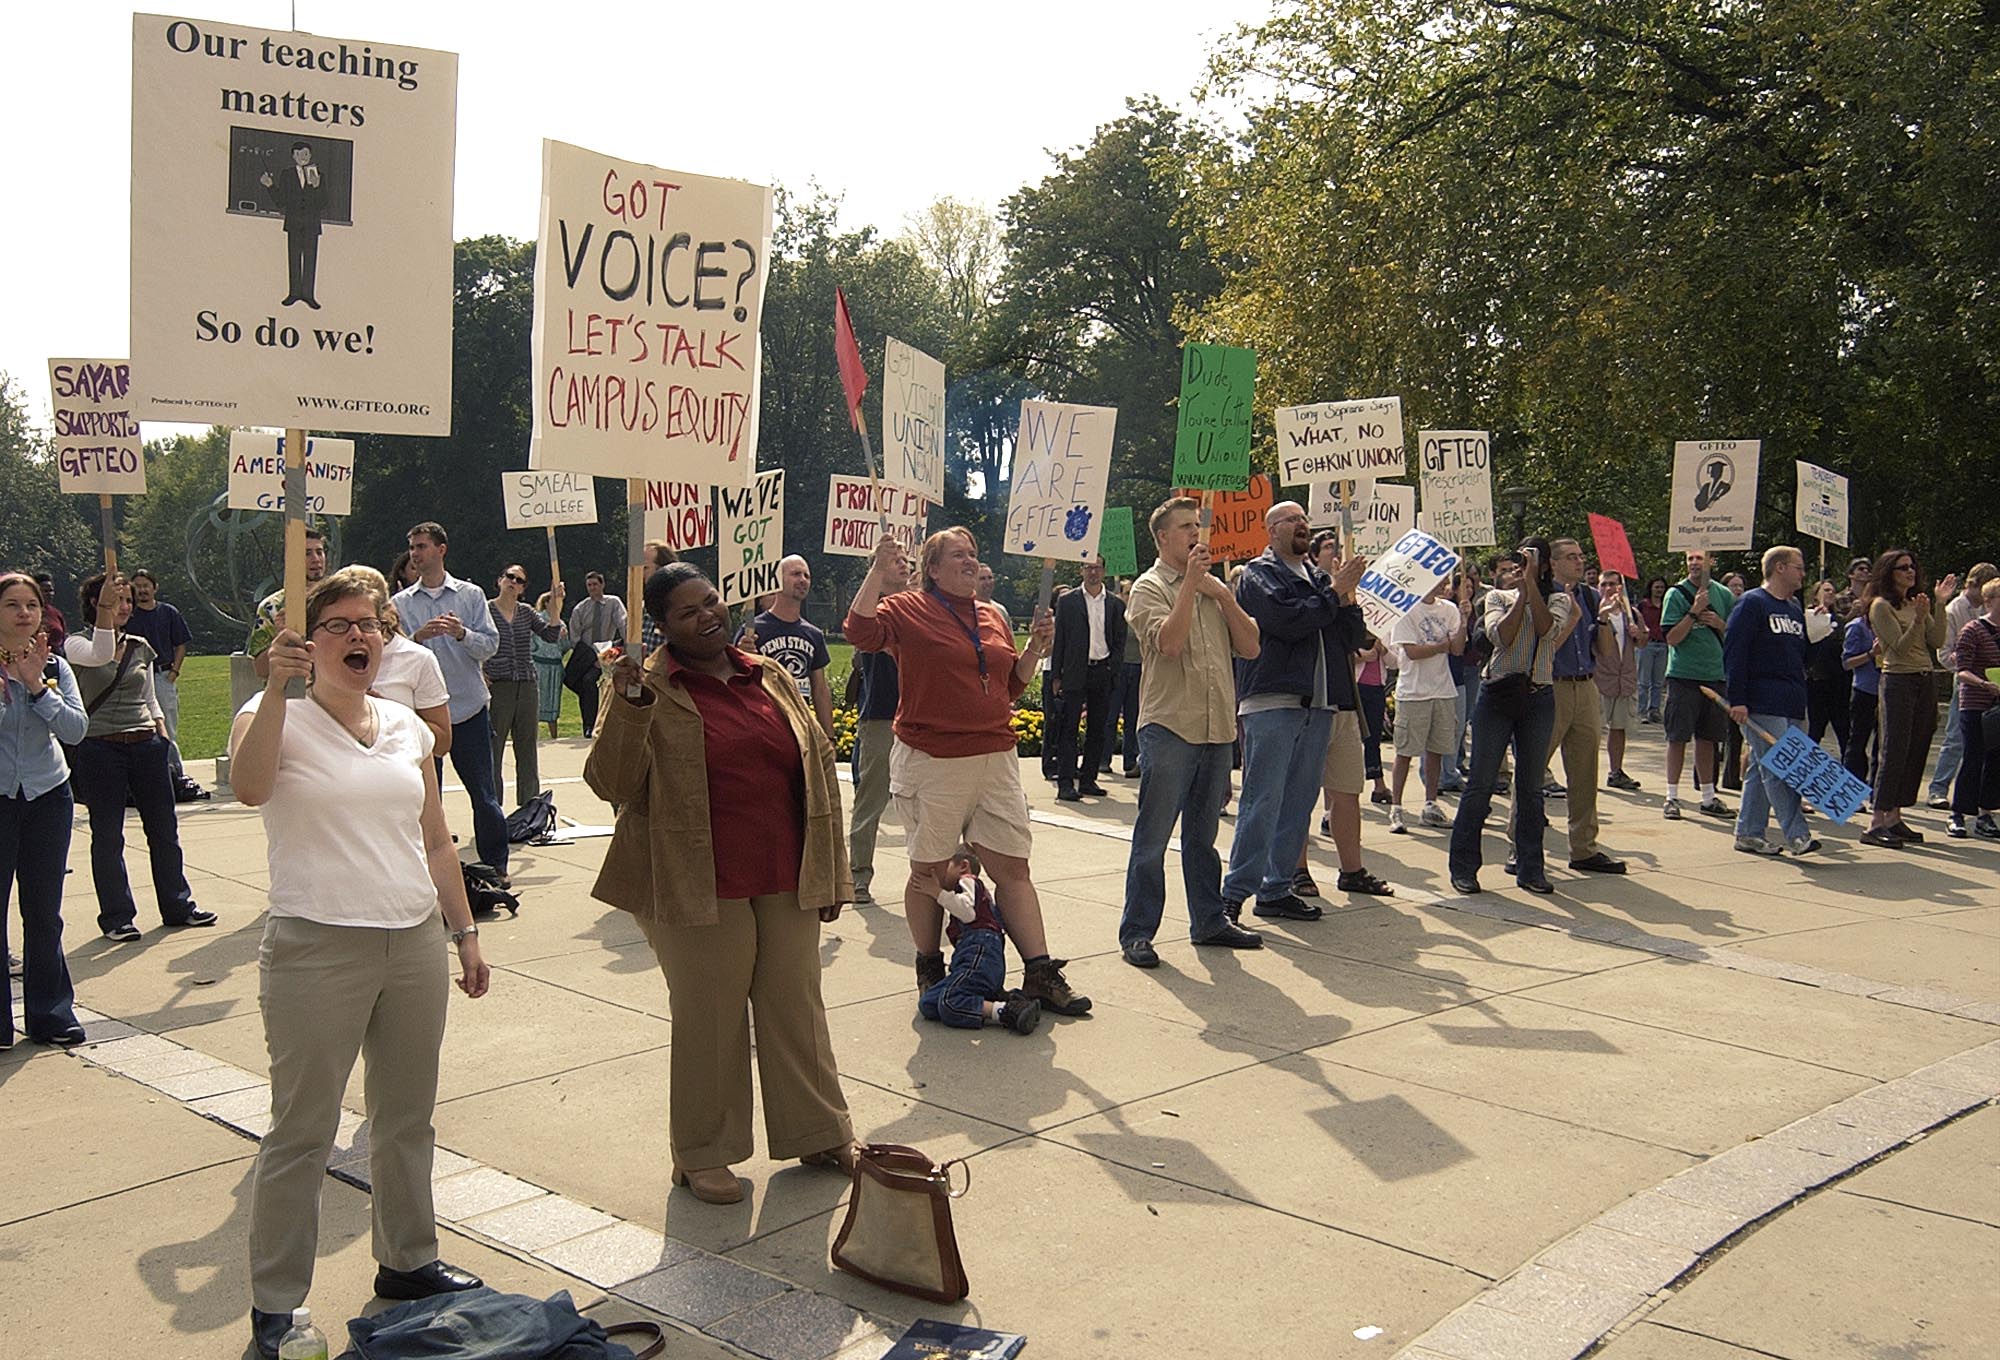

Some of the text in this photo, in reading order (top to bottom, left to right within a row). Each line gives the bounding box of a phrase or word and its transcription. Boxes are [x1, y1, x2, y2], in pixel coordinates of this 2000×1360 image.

[166, 20, 419, 90] Our teaching
[220, 87, 365, 127] matters
[603, 169, 683, 231] GOT
[559, 219, 756, 323] VOICE?
[196, 310, 375, 354] So do we!
[568, 307, 746, 372] LET'S TALK
[297, 396, 430, 416] WWW.GFTEO.ORG
[549, 367, 751, 462] CAMPUS EQUITY
[894, 411, 939, 457] UNION
[1027, 407, 1095, 458] WE
[1289, 423, 1384, 448] WHAT, NO
[1699, 442, 1737, 451] GFTEO
[60, 446, 137, 477] GFTEO
[1357, 446, 1404, 469] UNION?
[1425, 438, 1487, 471] GFTEO
[518, 473, 588, 498] SMEAL
[644, 480, 698, 511] NION
[721, 472, 783, 518] WE'VE
[1015, 460, 1094, 504] ARE
[257, 493, 325, 512] GFEO
[519, 500, 584, 518] COLLEGE
[1432, 508, 1488, 528] HEALTHY
[1692, 514, 1732, 523] Improving
[734, 517, 772, 544] GOT
[832, 517, 879, 550] PROTECT
[1678, 524, 1744, 534] Higher Education
[742, 542, 764, 566] DA
[1394, 532, 1456, 577] GFTEO
[722, 560, 780, 602] FUNK
[1359, 570, 1422, 613] UNION
[760, 636, 815, 657] PENN STATE
[1772, 736, 1807, 770] GFTEO
[1800, 760, 1845, 804] CAUCUS
[1824, 776, 1865, 817] BLACK
